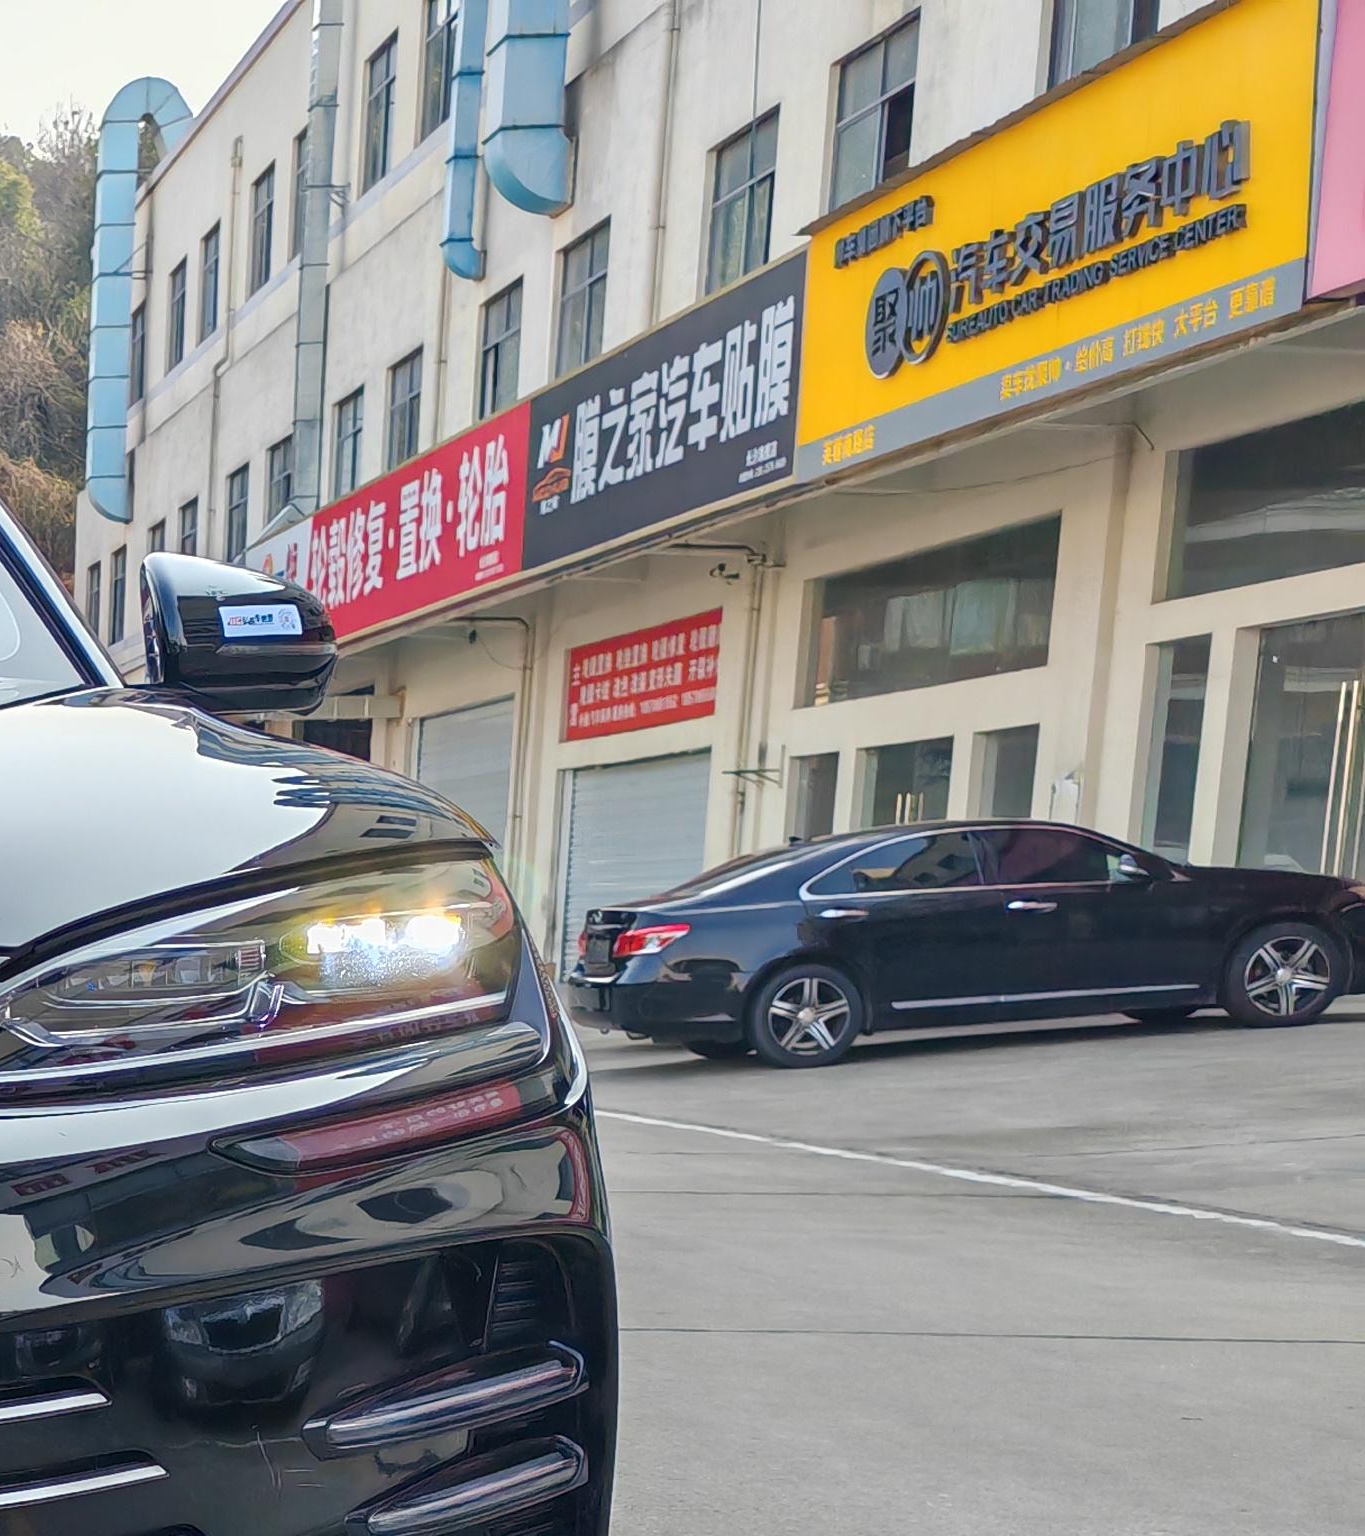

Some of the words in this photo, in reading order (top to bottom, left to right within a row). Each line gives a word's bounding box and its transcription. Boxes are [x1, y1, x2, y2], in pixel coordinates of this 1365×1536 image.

[951, 120, 1250, 312] 汽车交易服务中心
[1011, 288, 1040, 317] CAR
[1042, 262, 1106, 305] TRADING
[1109, 234, 1172, 278] SERVICE
[1173, 204, 1245, 250] CENTER
[1173, 298, 1219, 339] 大平台
[570, 295, 795, 504] 膜之家汽车贴膜
